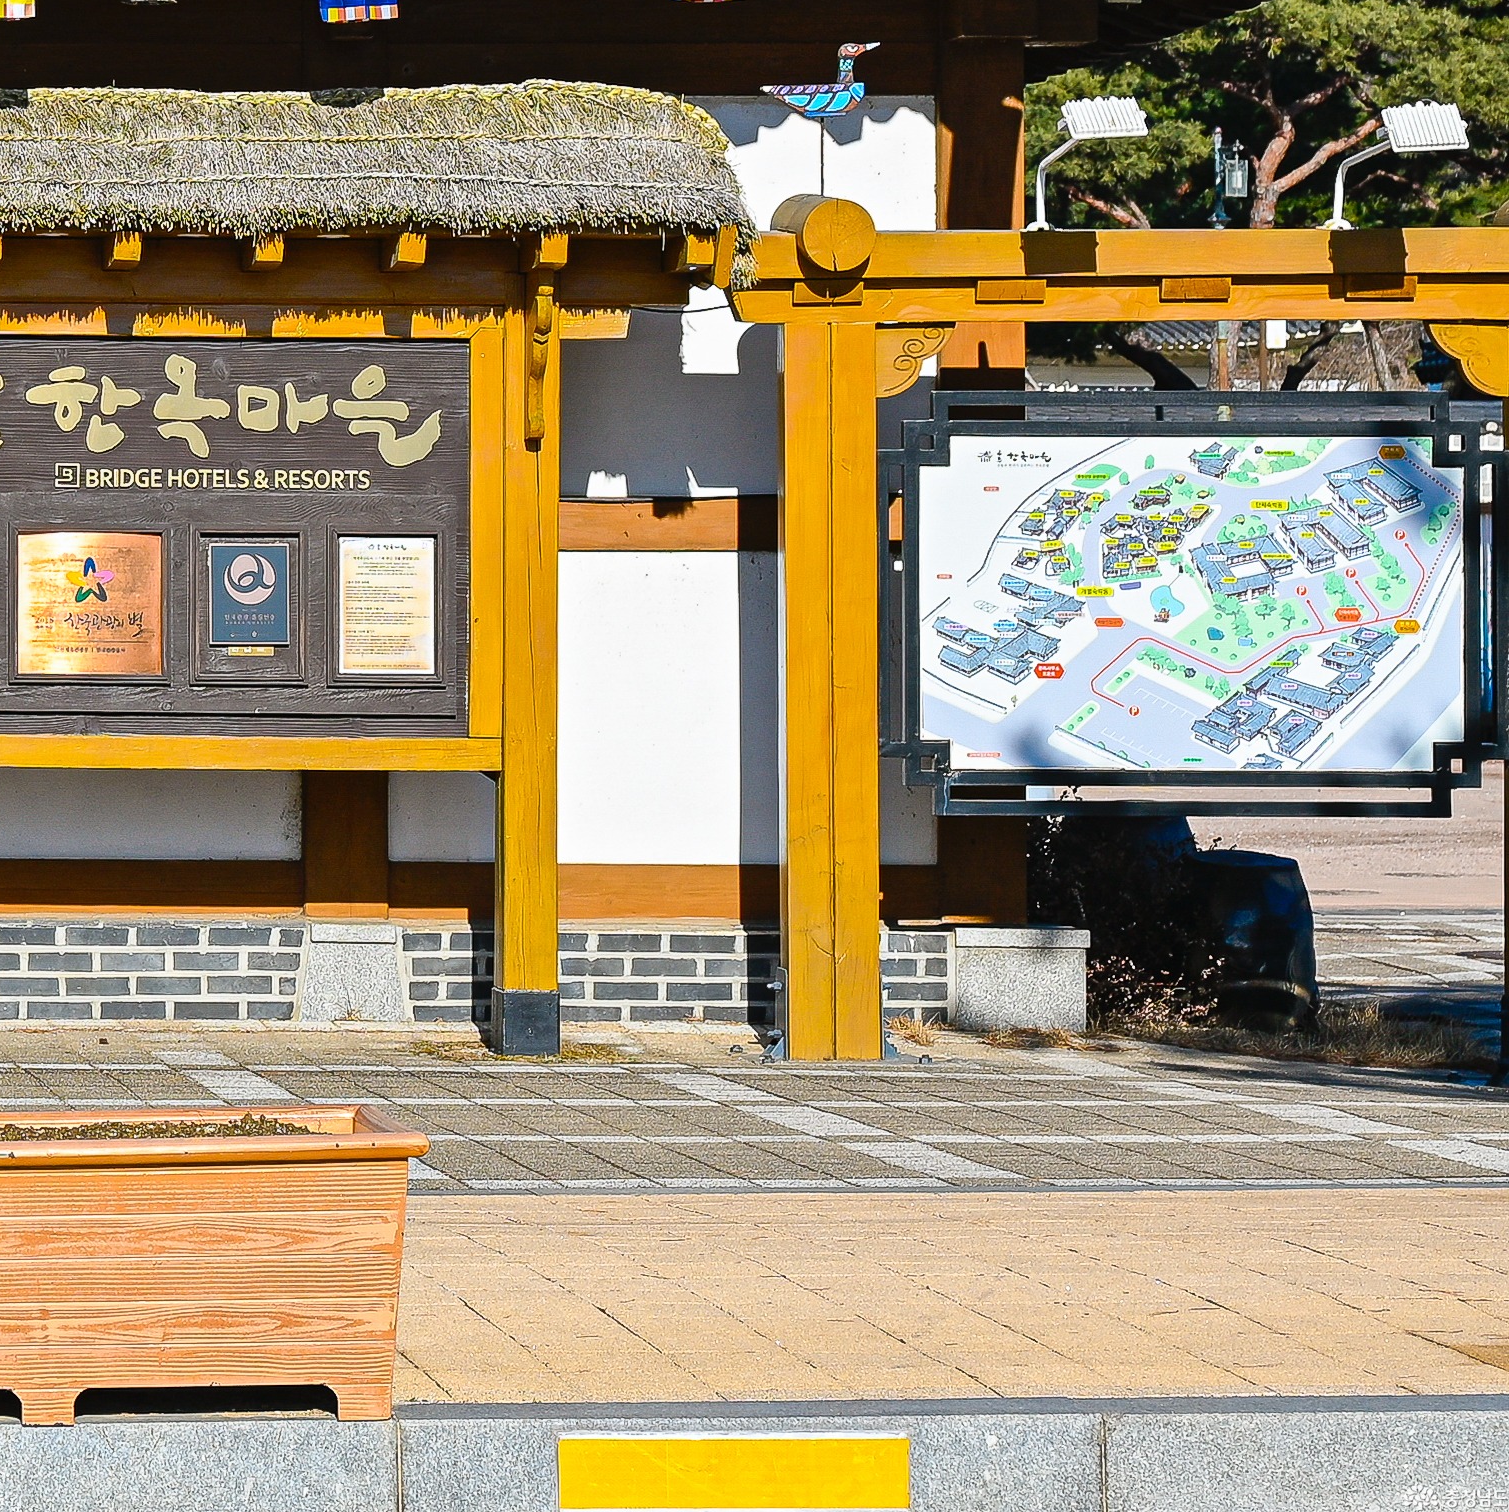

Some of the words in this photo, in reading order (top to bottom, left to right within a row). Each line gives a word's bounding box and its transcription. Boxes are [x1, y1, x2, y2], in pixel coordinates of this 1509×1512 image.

[25, 353, 444, 468] 한옥마을
[85, 468, 163, 489] BRIDGE
[167, 468, 249, 489] HOTELS
[253, 469, 270, 489] &
[274, 469, 371, 489] RESORTS
[128, 611, 144, 637] 별
